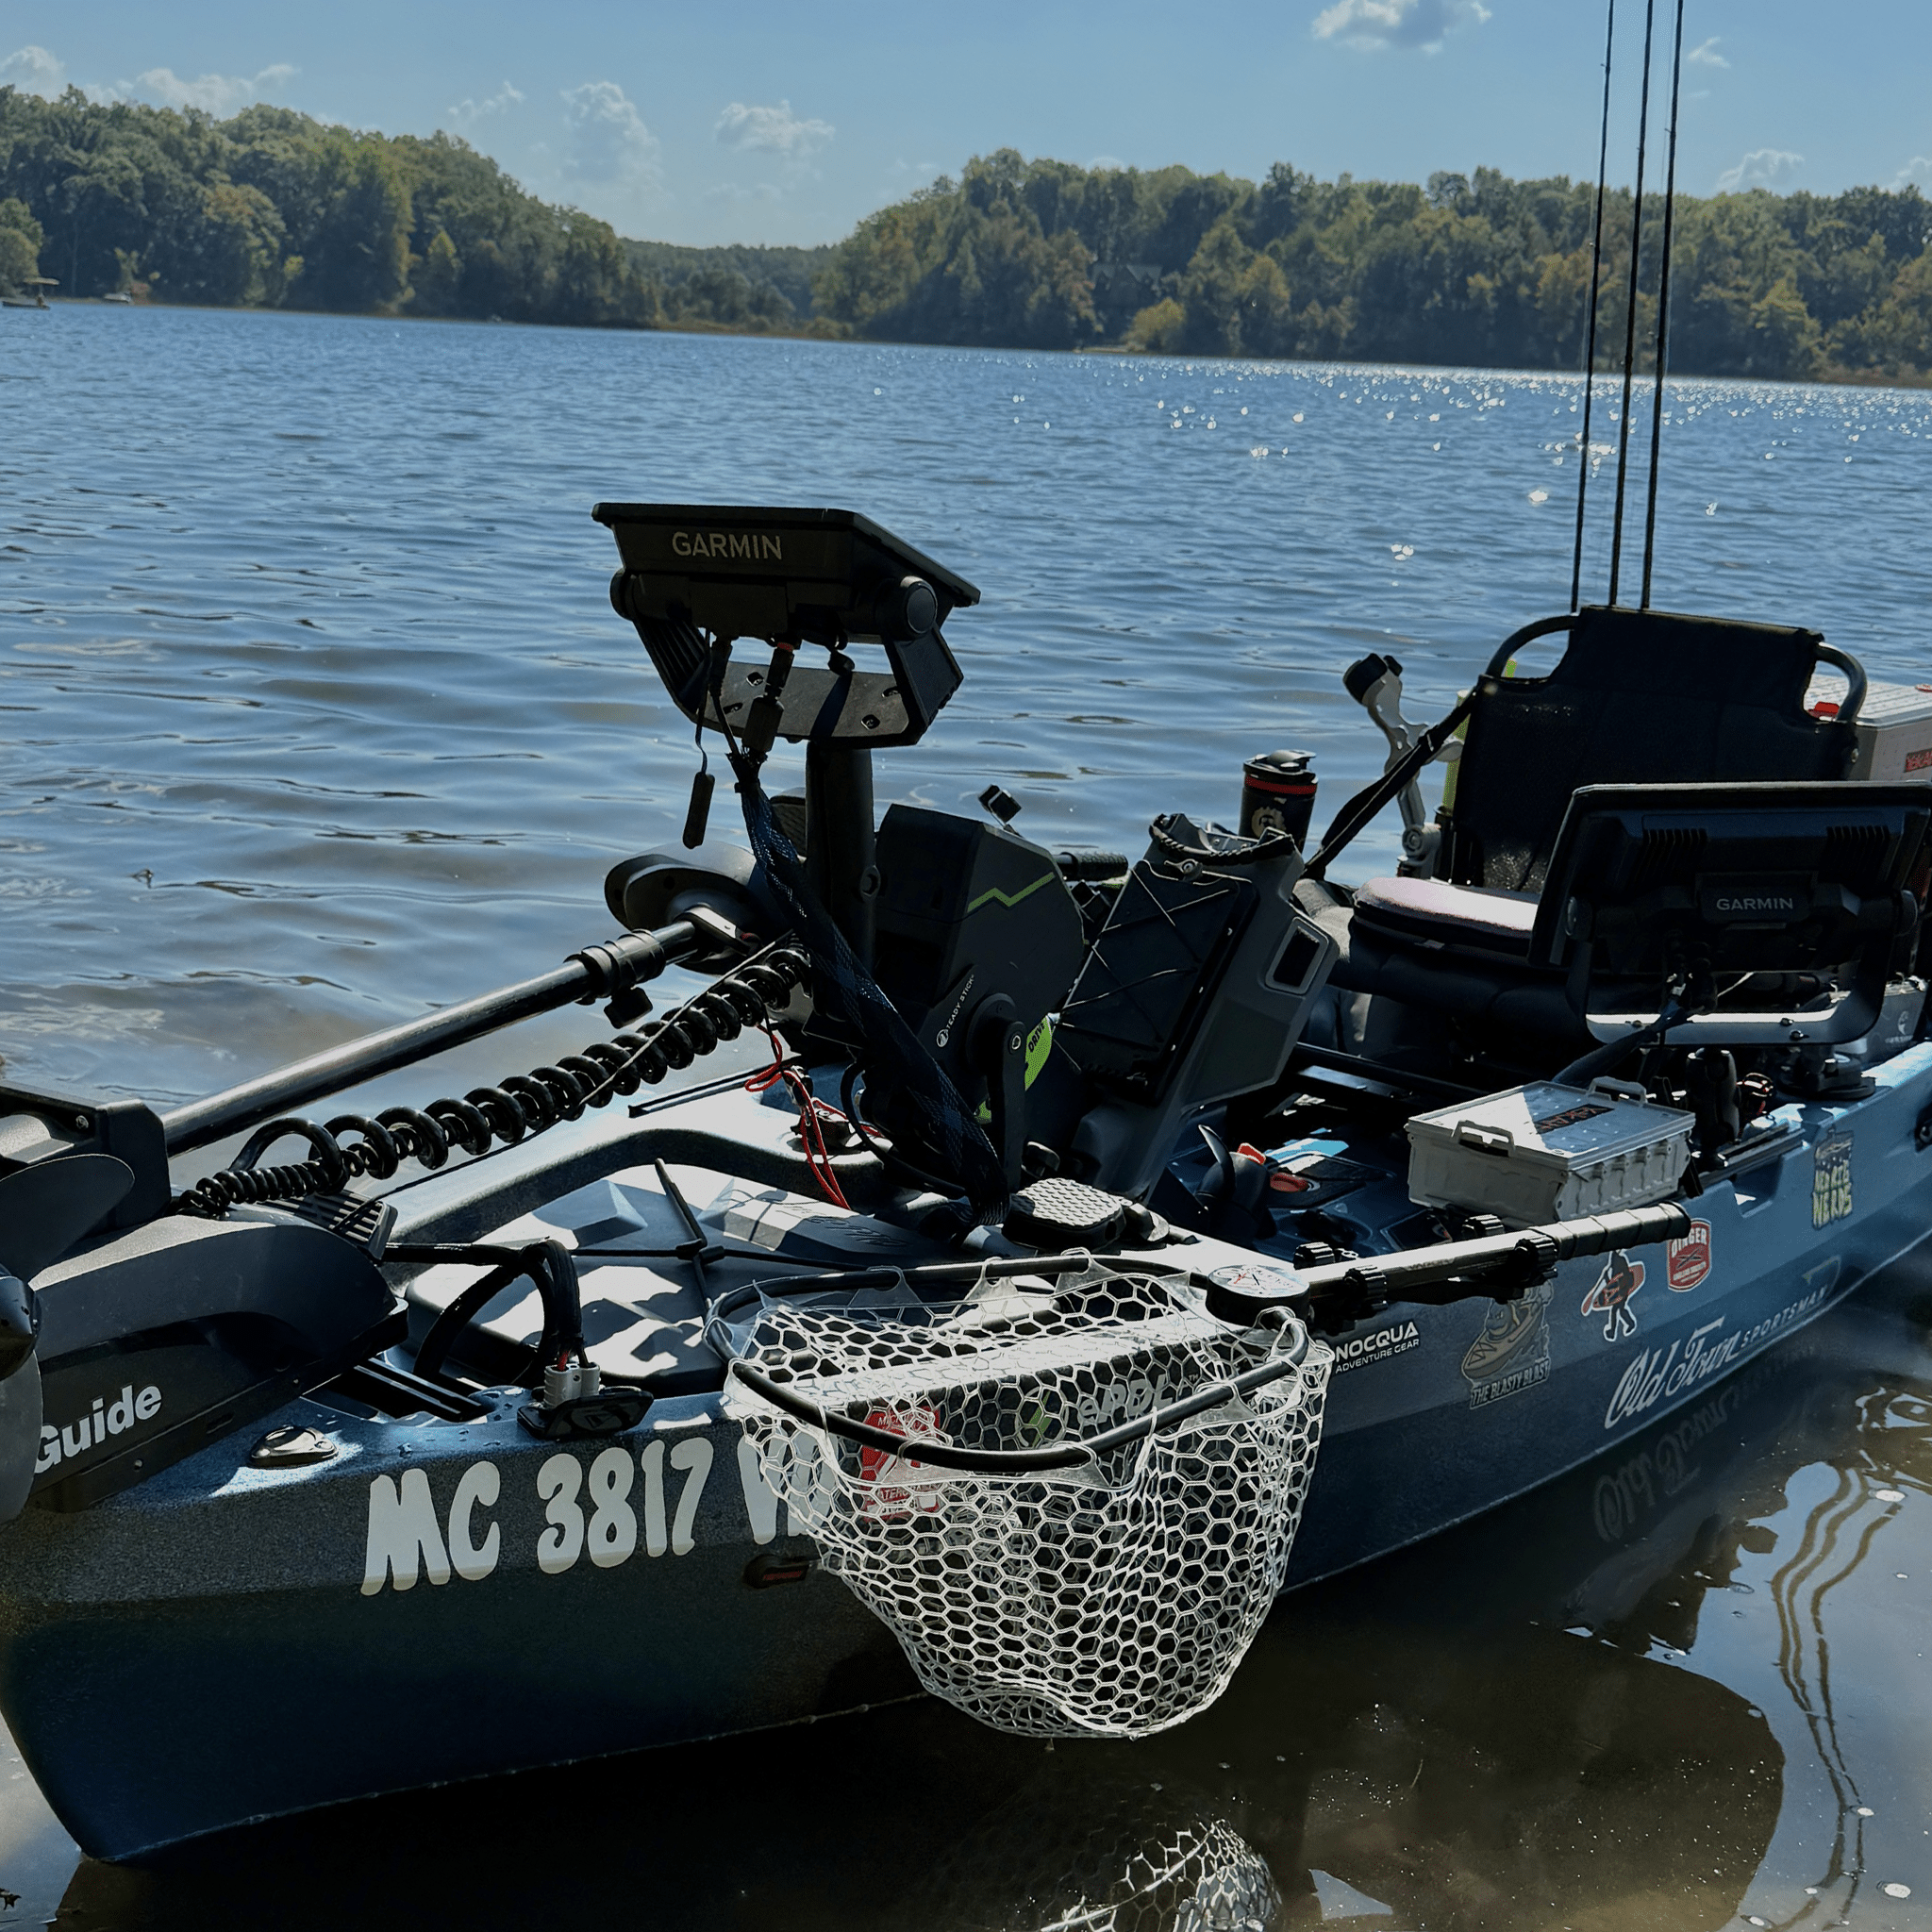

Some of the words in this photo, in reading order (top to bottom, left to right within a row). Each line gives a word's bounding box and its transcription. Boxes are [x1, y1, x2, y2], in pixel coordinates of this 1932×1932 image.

[672, 531, 782, 559] GARMIN
[1716, 897, 1793, 910] GARMIN
[1335, 1321, 1420, 1363] NOCQUA
[1335, 1347, 1393, 1374] ADVENTURE
[1393, 1338, 1420, 1354] GEAR
[1605, 1339, 1681, 1429] Old
[1665, 1315, 1743, 1396] Town
[1740, 1284, 1828, 1348] SPORTSMAN
[1472, 1384, 1491, 1407] THE
[359, 1459, 501, 1596] MC
[536, 1436, 714, 1574] 3817
